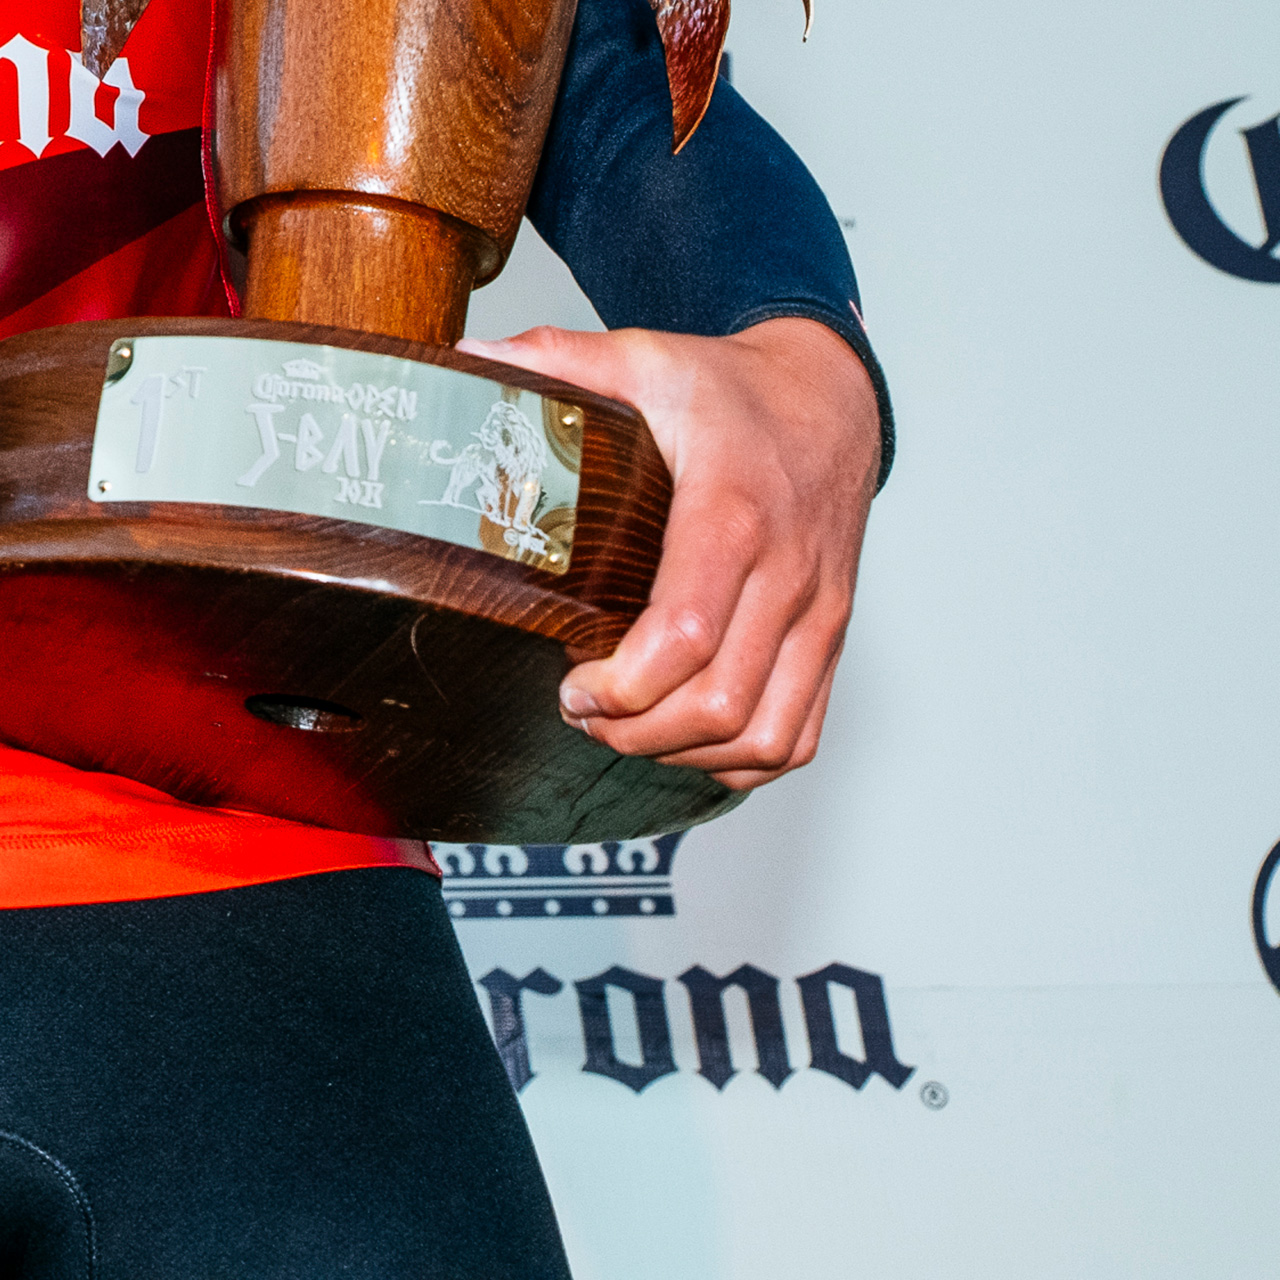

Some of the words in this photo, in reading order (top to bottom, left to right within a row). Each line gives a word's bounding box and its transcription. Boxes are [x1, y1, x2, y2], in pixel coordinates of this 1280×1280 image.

[251, 373, 345, 404] Corona
[344, 381, 418, 421] OPEN
[235, 402, 392, 488] J-BAY
